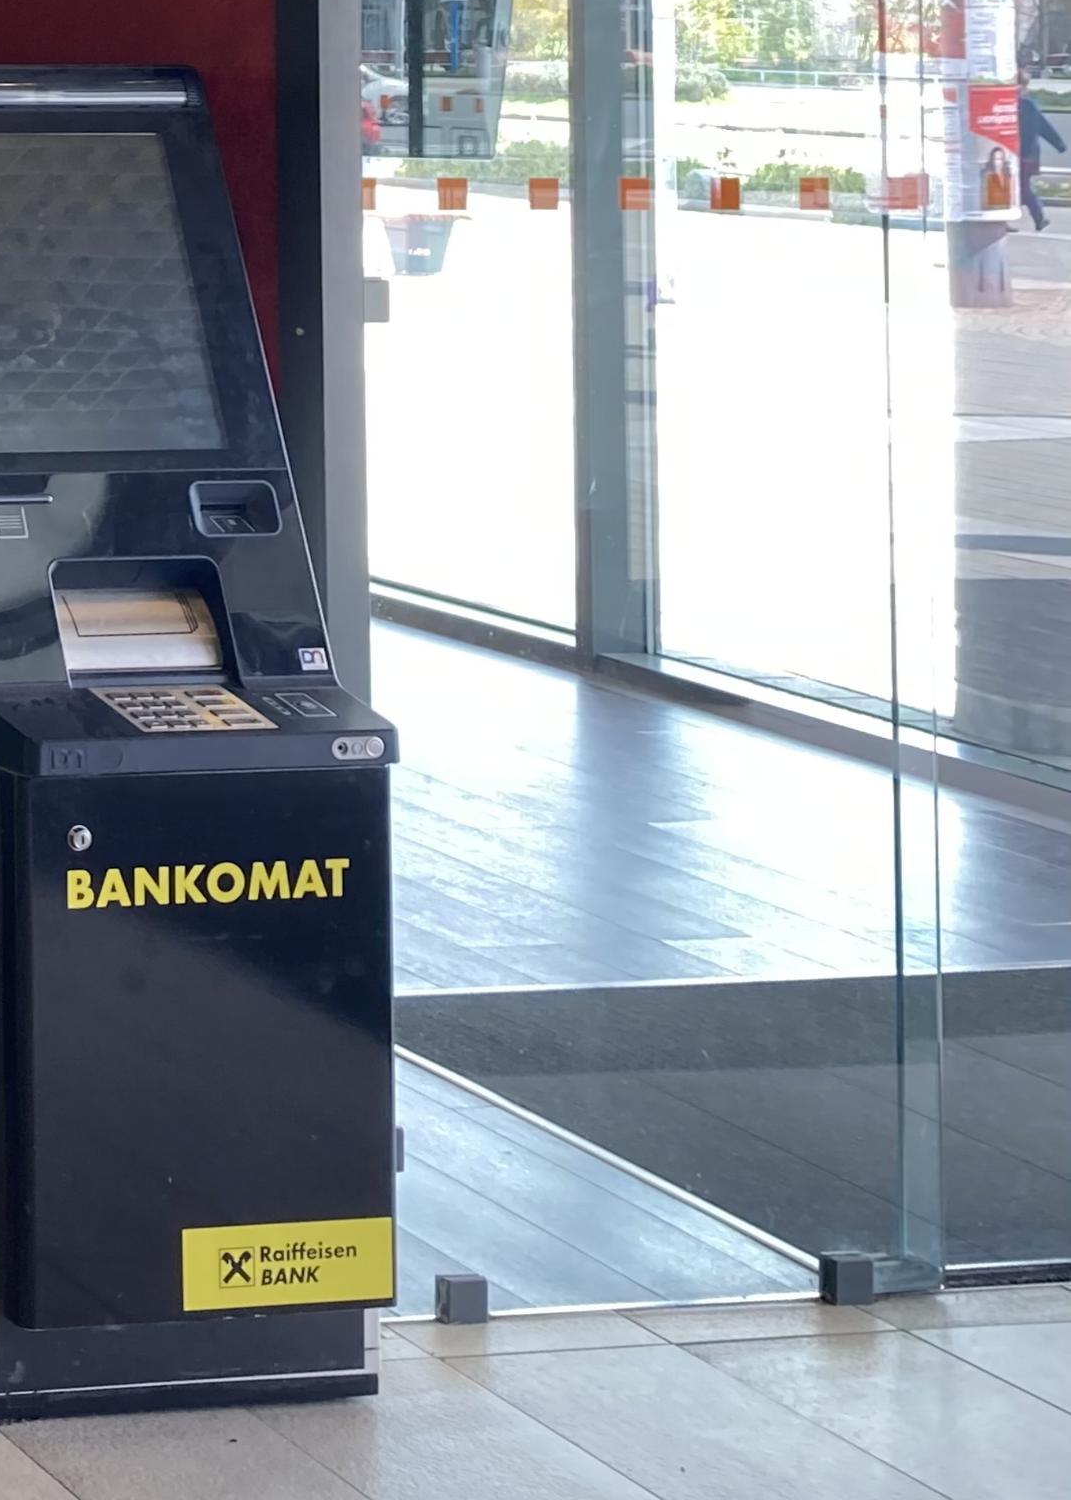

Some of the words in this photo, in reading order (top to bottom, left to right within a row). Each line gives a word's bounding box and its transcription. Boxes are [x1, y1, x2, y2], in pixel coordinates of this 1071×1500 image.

[66, 858, 350, 910] BANKOMAT
[260, 1241, 357, 1263] Raiffeisen
[261, 1266, 320, 1286] BANK
